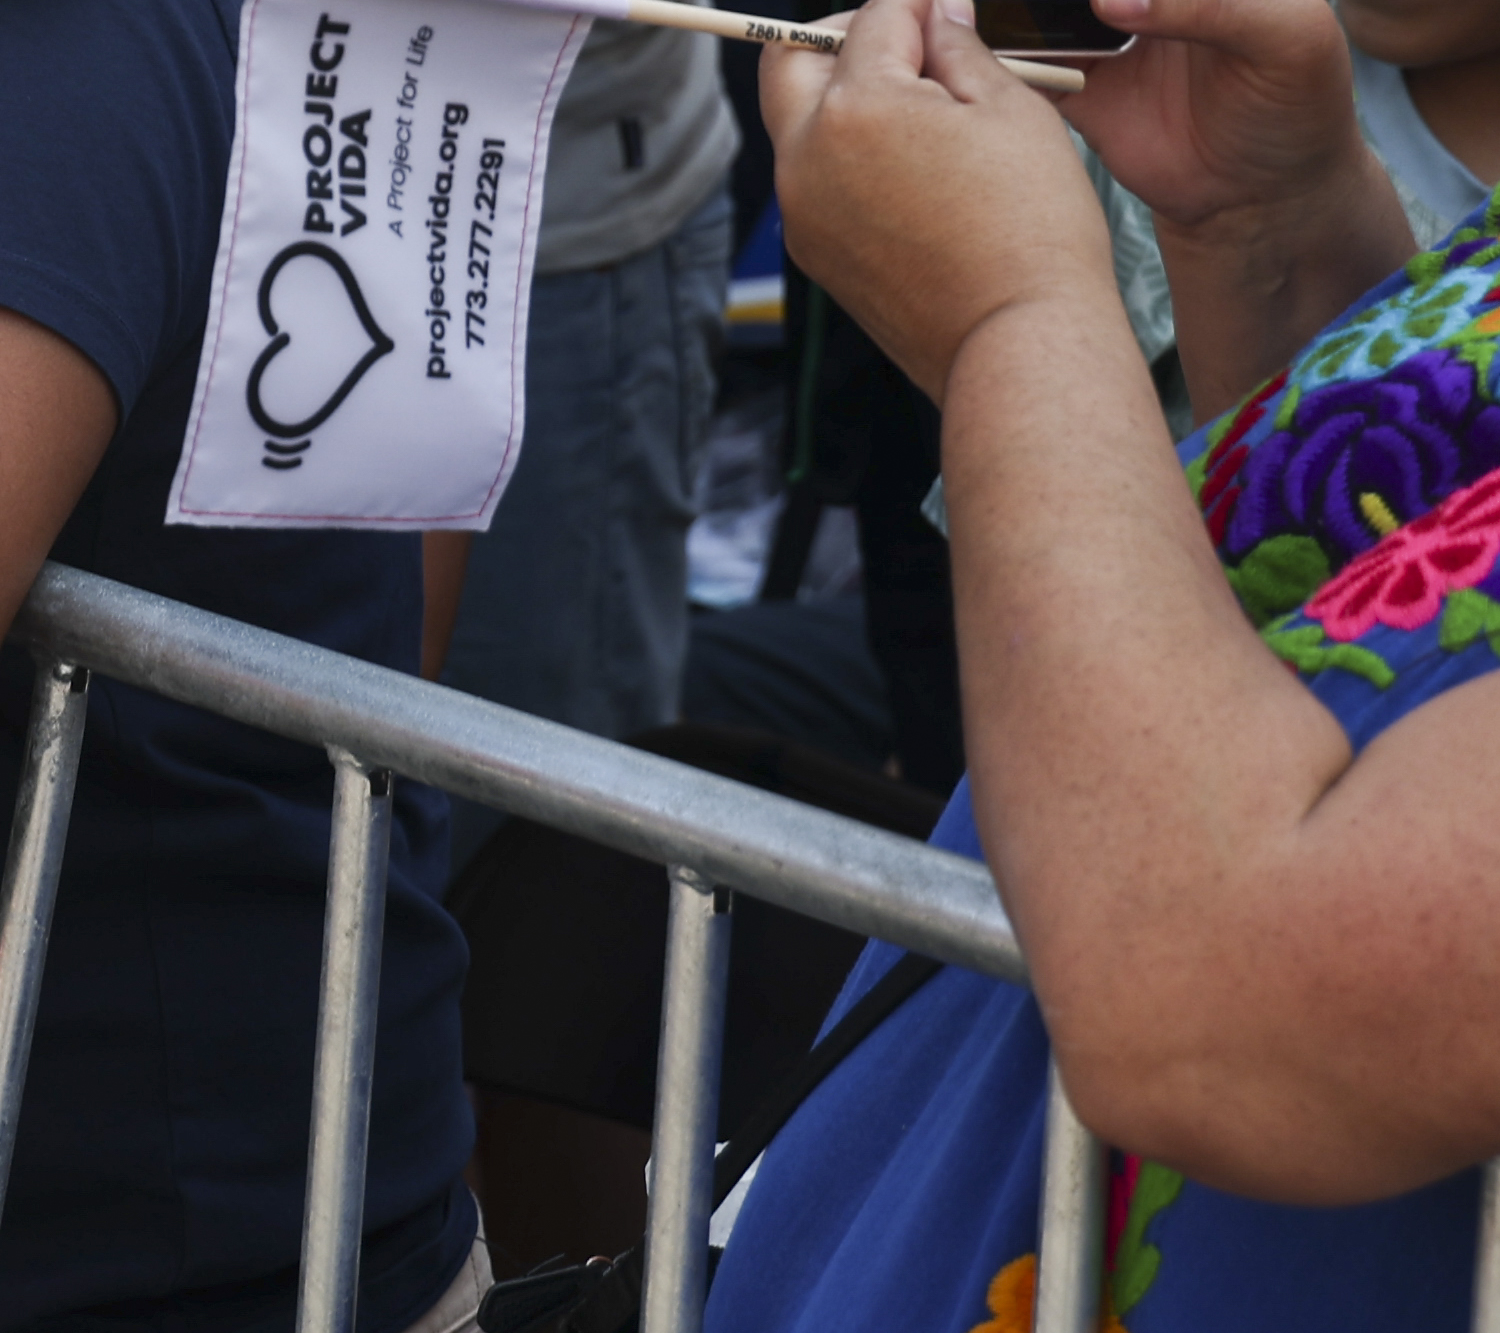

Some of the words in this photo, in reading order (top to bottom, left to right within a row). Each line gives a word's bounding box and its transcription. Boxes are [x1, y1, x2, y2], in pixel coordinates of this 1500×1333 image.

[405, 24, 435, 67] Life
[745, 21, 782, 41] 1992
[790, 29, 835, 50] Since
[302, 12, 351, 235] PROJECT
[396, 70, 419, 110] for
[337, 108, 372, 238] VIDA
[387, 115, 413, 211] Project
[387, 220, 404, 239] A
[426, 102, 469, 379] projectvida.org
[465, 137, 506, 350] 773.277.2291
